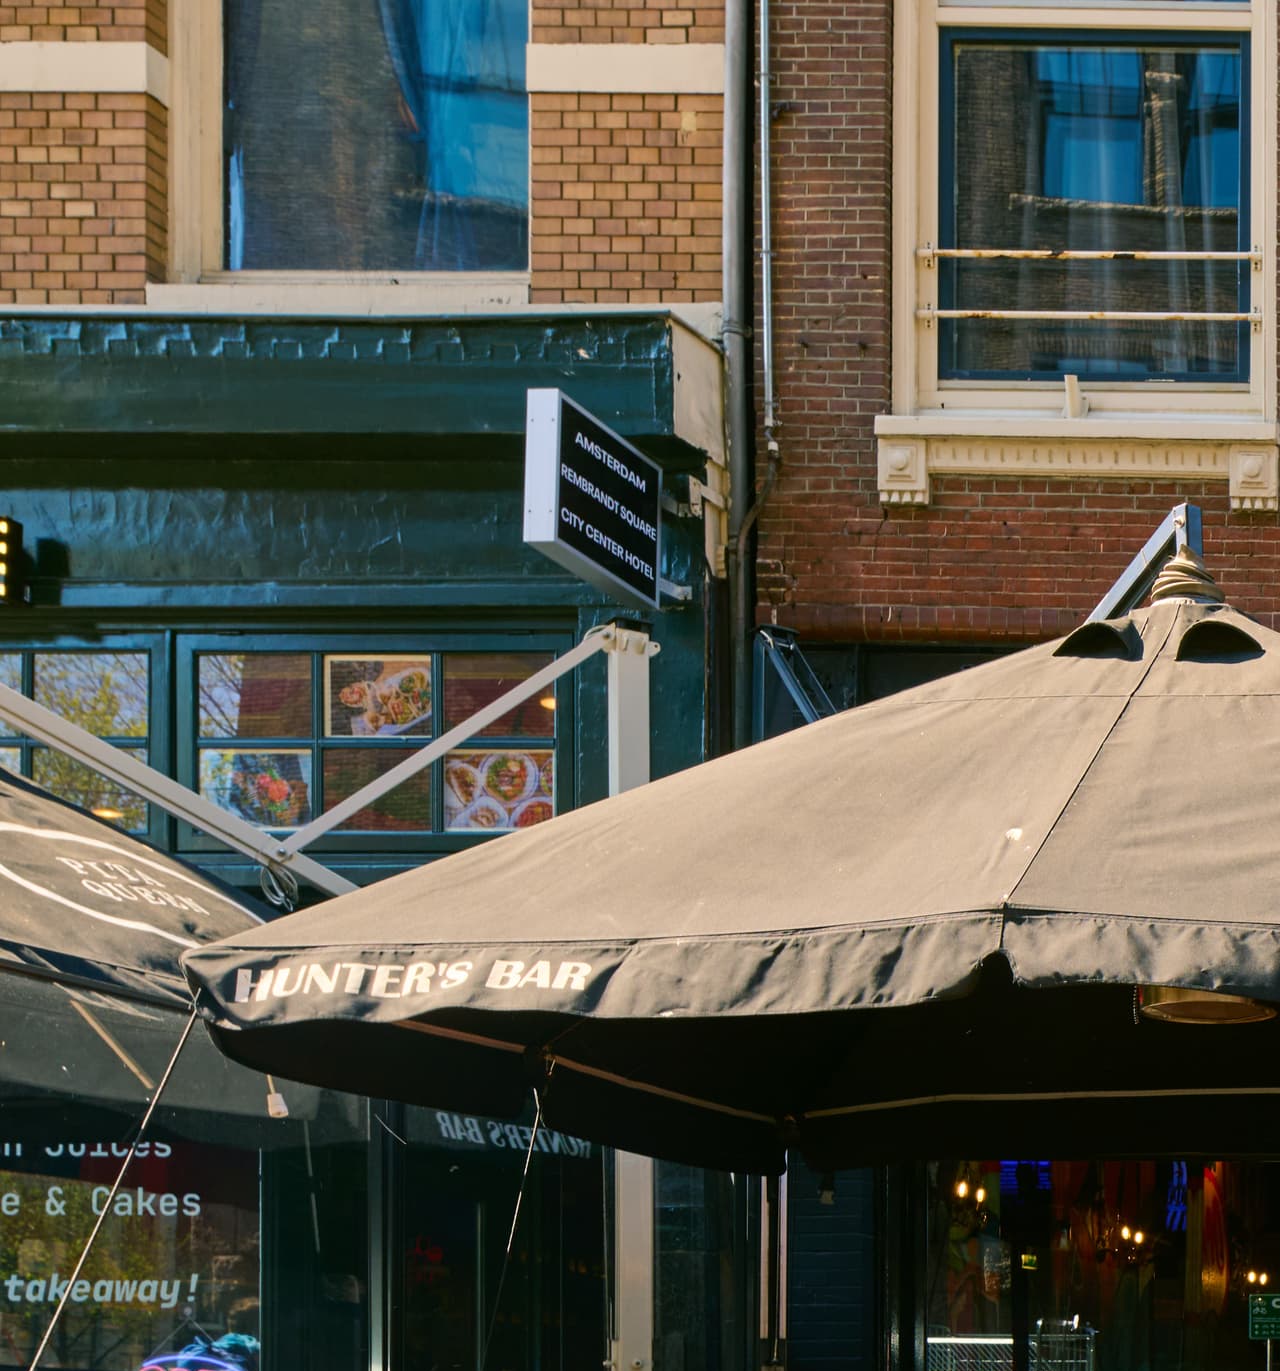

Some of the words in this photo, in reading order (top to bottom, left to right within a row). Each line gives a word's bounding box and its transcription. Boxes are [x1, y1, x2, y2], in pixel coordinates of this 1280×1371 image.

[575, 431, 646, 492] AMSTERDAM
[561, 463, 620, 514] REMBRANDT
[620, 506, 657, 541] SQUARE
[561, 507, 584, 532] CITY
[586, 524, 624, 560] CENTER
[625, 550, 654, 580] HOTEL
[56, 857, 166, 889] PITA
[81, 879, 210, 916] QUEEN
[234, 960, 473, 1003] HUNTER'S
[485, 960, 592, 991] BAR
[45, 1186, 67, 1217] &
[91, 1186, 202, 1217] Cakes
[4, 1273, 199, 1309] takeaway!
